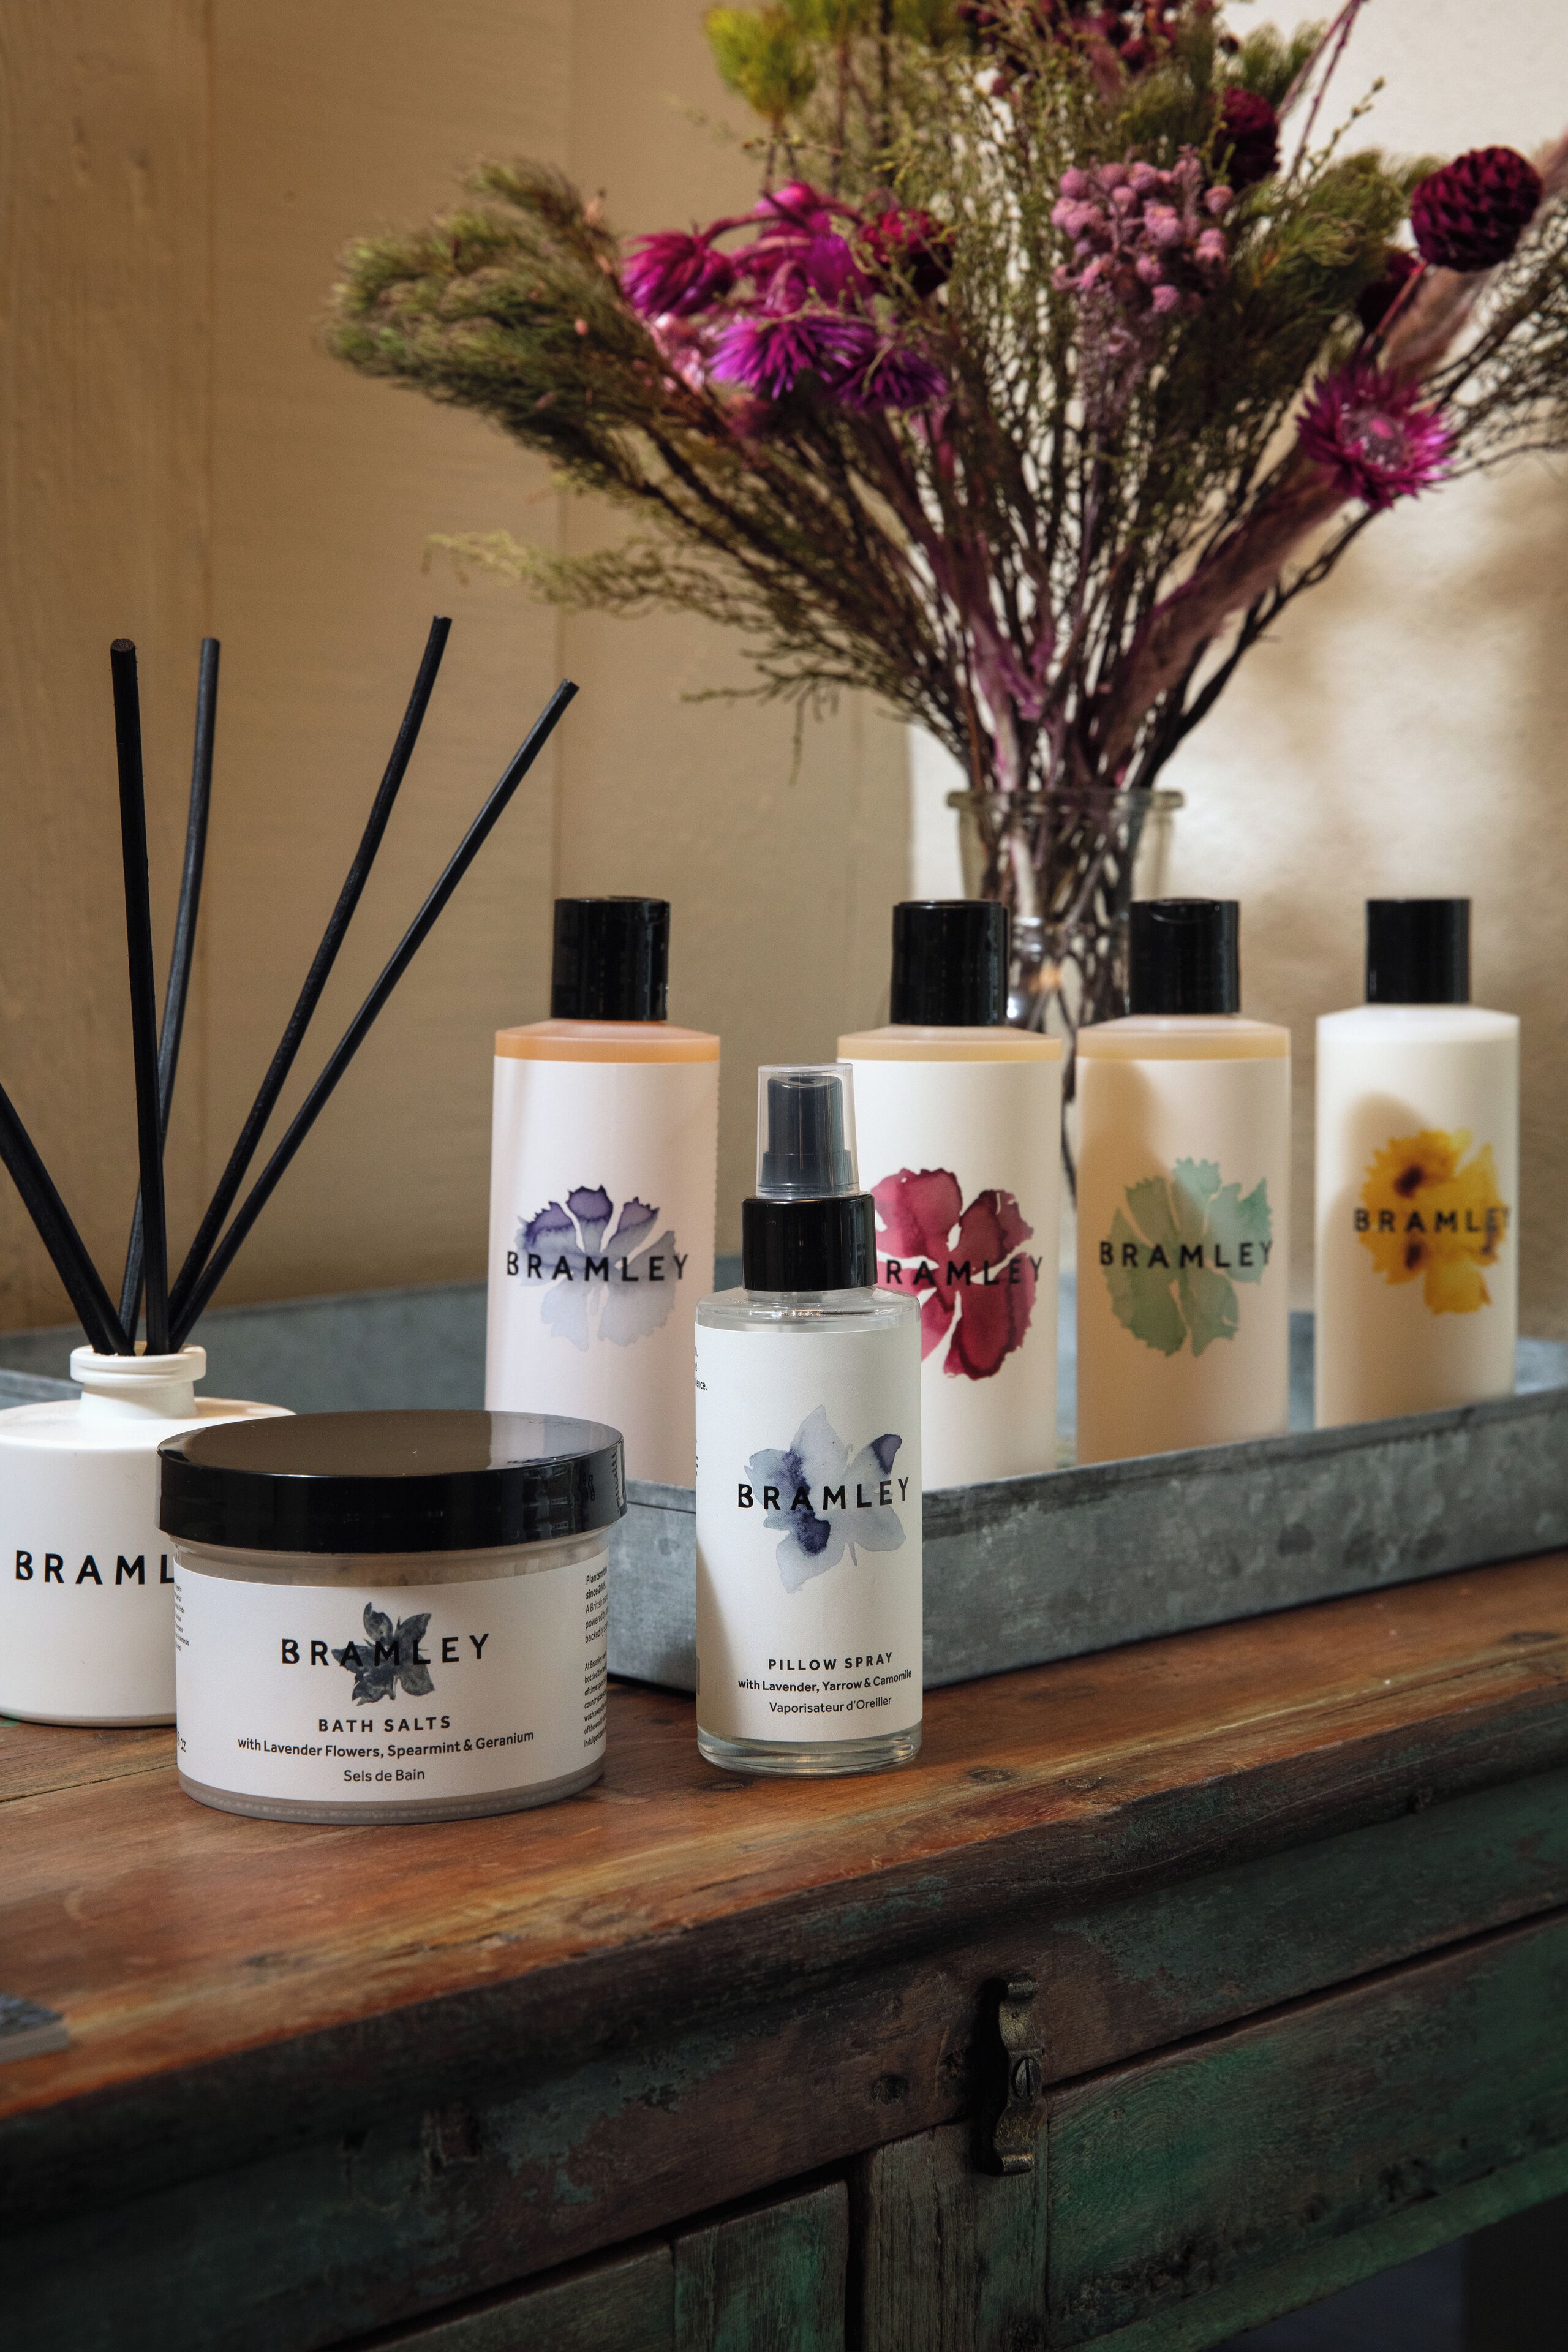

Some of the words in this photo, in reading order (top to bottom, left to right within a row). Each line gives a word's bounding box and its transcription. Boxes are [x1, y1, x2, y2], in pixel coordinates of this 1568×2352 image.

[1100, 1240, 1274, 1268] BRAMLEY
[507, 1251, 688, 1281] BRAMLEY
[885, 1256, 1043, 1286] RAMLEY
[737, 1476, 909, 1510] BRAMLEY
[15, 1550, 174, 1585] BRAML
[586, 1589, 598, 1600] since
[586, 1604, 590, 1615] A
[590, 1599, 602, 1612] British
[585, 1612, 603, 1631] powered
[585, 1627, 600, 1643] backed
[281, 1634, 489, 1667] BRAMLEY
[584, 1662, 590, 1671] At
[769, 1659, 837, 1671] PILLOW
[845, 1651, 892, 1669] SPRAY
[584, 1673, 598, 1684] bottled
[738, 1679, 760, 1690] with
[763, 1681, 820, 1693] Lavender,
[822, 1681, 862, 1691] Yarrow
[864, 1678, 871, 1688] &
[873, 1669, 912, 1686] Camomile
[584, 1686, 589, 1697] of
[769, 1702, 844, 1715] Vaporisateur
[846, 1696, 892, 1711] d'Oreiller
[318, 1719, 373, 1732] BATH
[384, 1715, 450, 1732] SALTS
[238, 1738, 261, 1751] with
[263, 1740, 322, 1756] Lavender
[325, 1744, 384, 1758] Flowers,
[388, 1741, 461, 1759] Spearmint
[463, 1739, 473, 1751] &
[475, 1732, 534, 1750] Geranium
[344, 1770, 372, 1782] Sels
[375, 1770, 392, 1782] de
[396, 1769, 425, 1781] Bain
